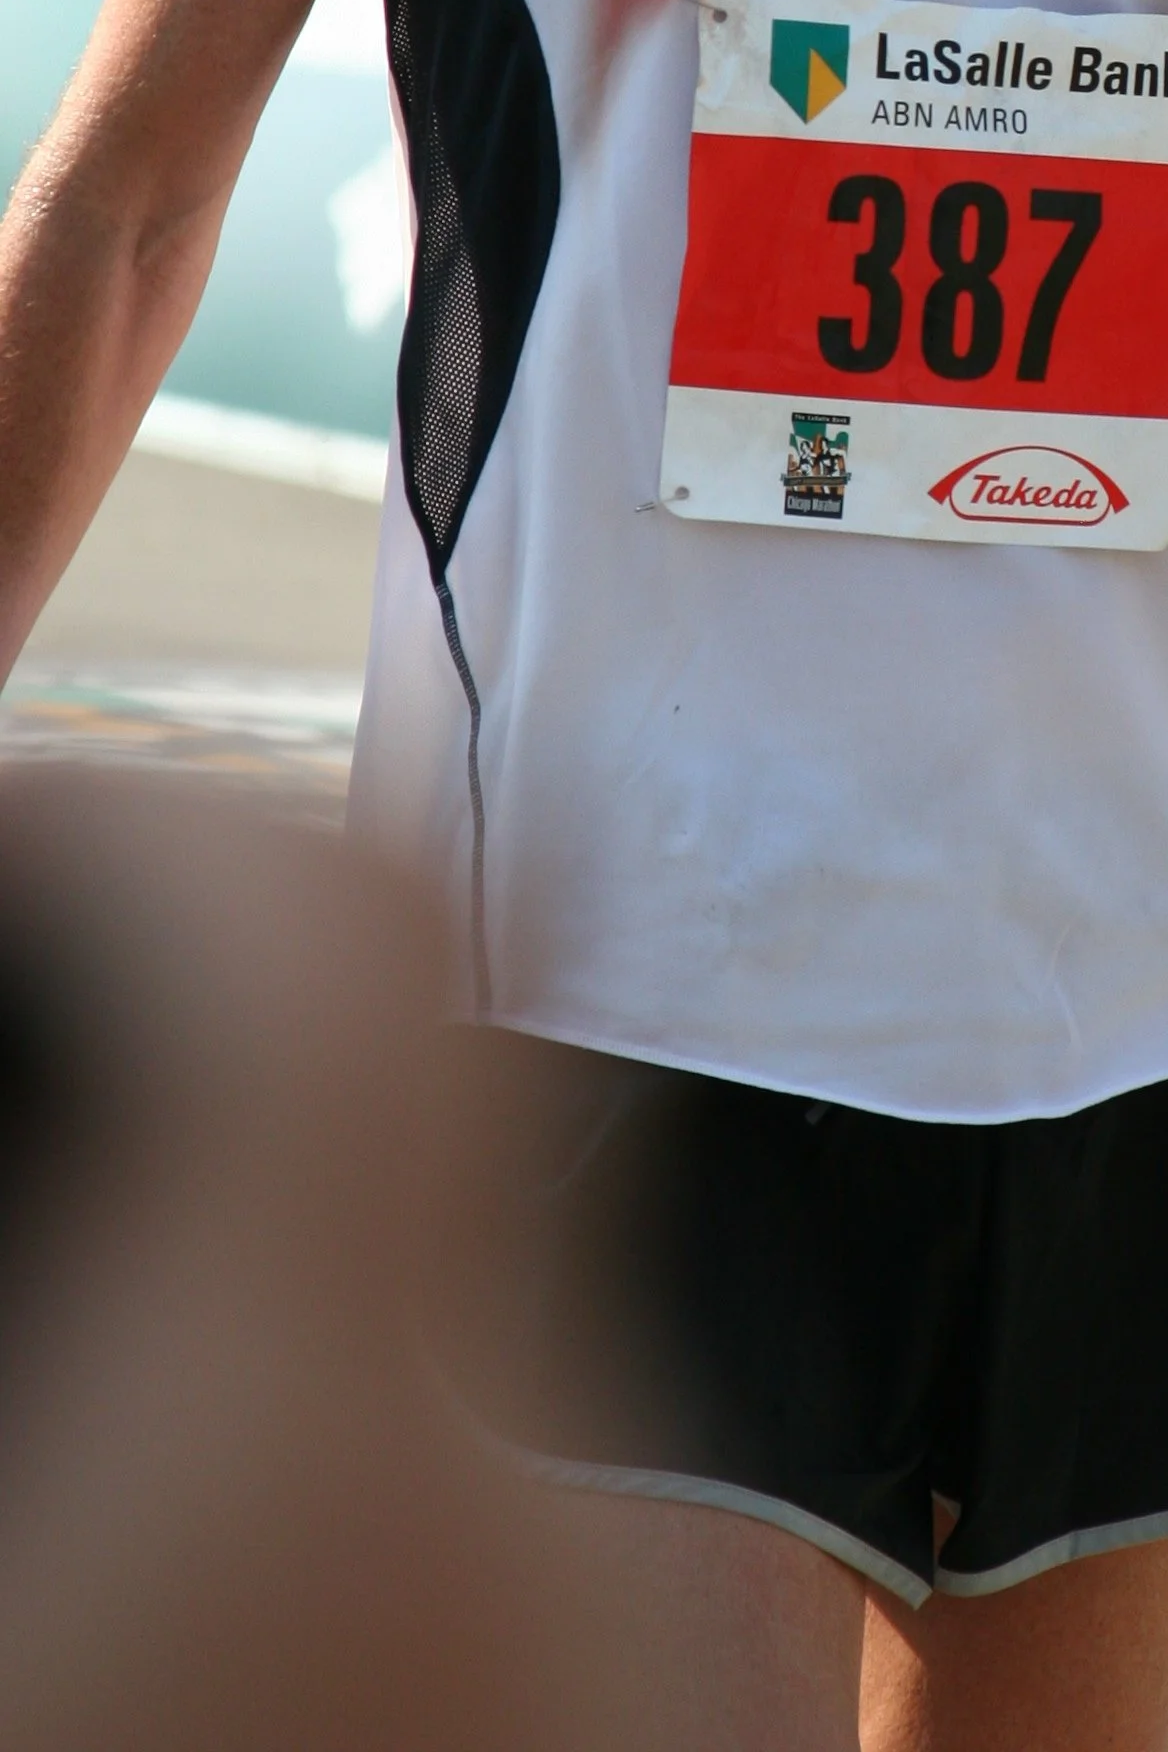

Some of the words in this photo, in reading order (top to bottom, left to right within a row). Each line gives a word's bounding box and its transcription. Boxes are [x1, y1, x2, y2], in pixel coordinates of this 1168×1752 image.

[876, 32, 1052, 91] LaSalle
[872, 100, 933, 128] ABN
[944, 105, 1028, 134] AMRO
[817, 174, 1104, 383] 387
[970, 474, 1098, 510] Takeda
